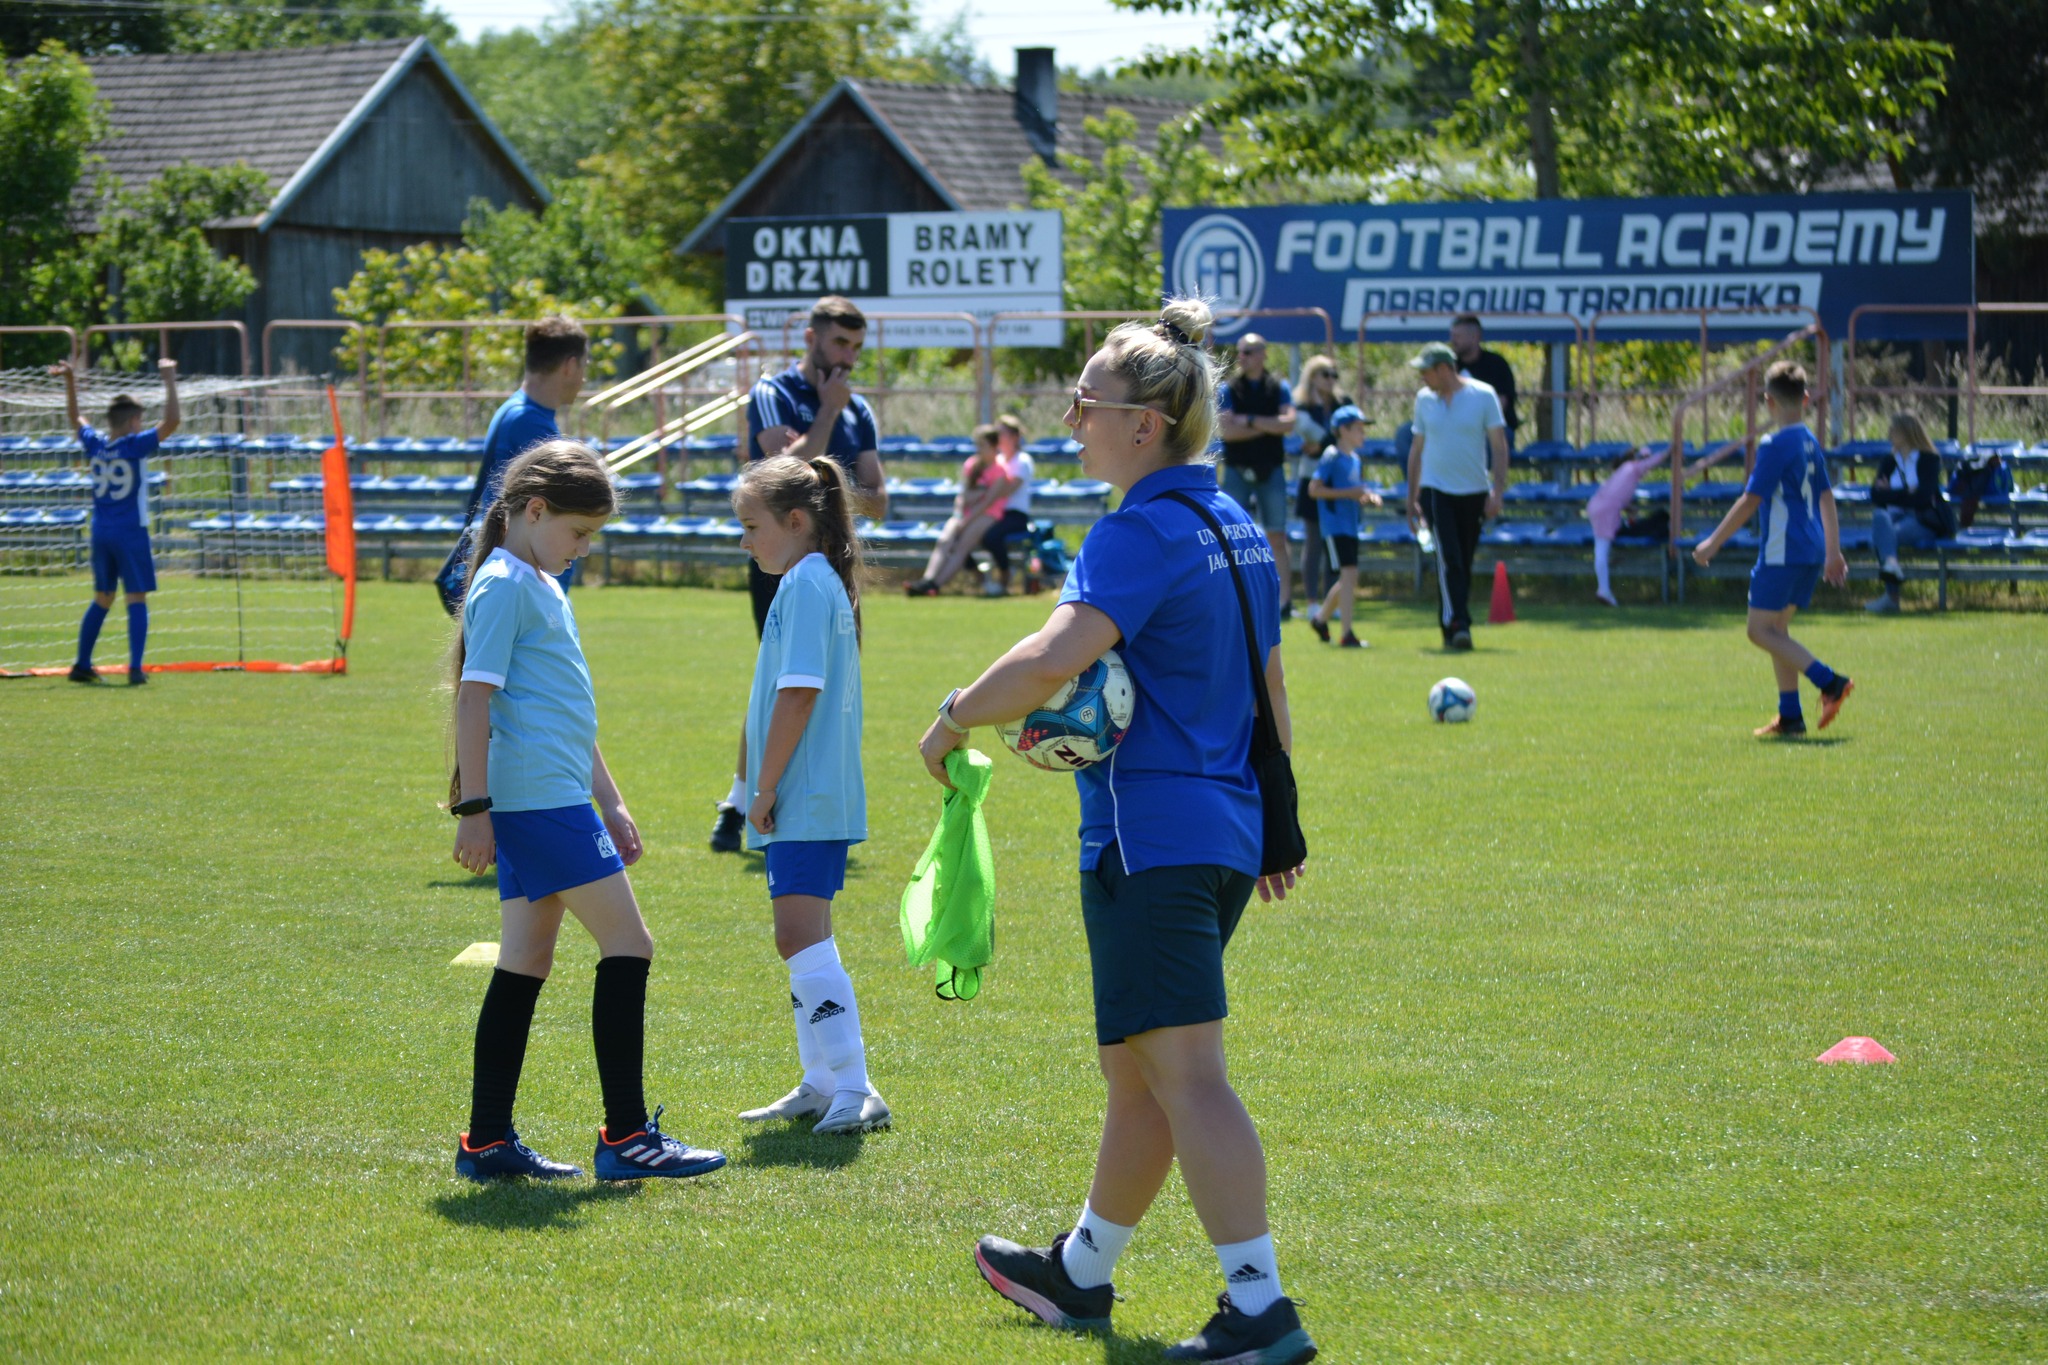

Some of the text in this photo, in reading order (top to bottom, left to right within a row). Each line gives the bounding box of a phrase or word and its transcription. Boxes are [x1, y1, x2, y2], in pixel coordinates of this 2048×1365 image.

[753, 225, 863, 259] OKNA
[914, 222, 1035, 252] BRAMY
[1276, 208, 1947, 273] FOOTBALL ACADEMY
[746, 258, 871, 293] DRZWI
[908, 256, 1042, 287] ROLETY
[1556, 283, 1803, 316] TARNOWSKA
[91, 457, 134, 500] 99
[809, 1006, 846, 1025] adidas
[479, 1147, 499, 1159] COPA
